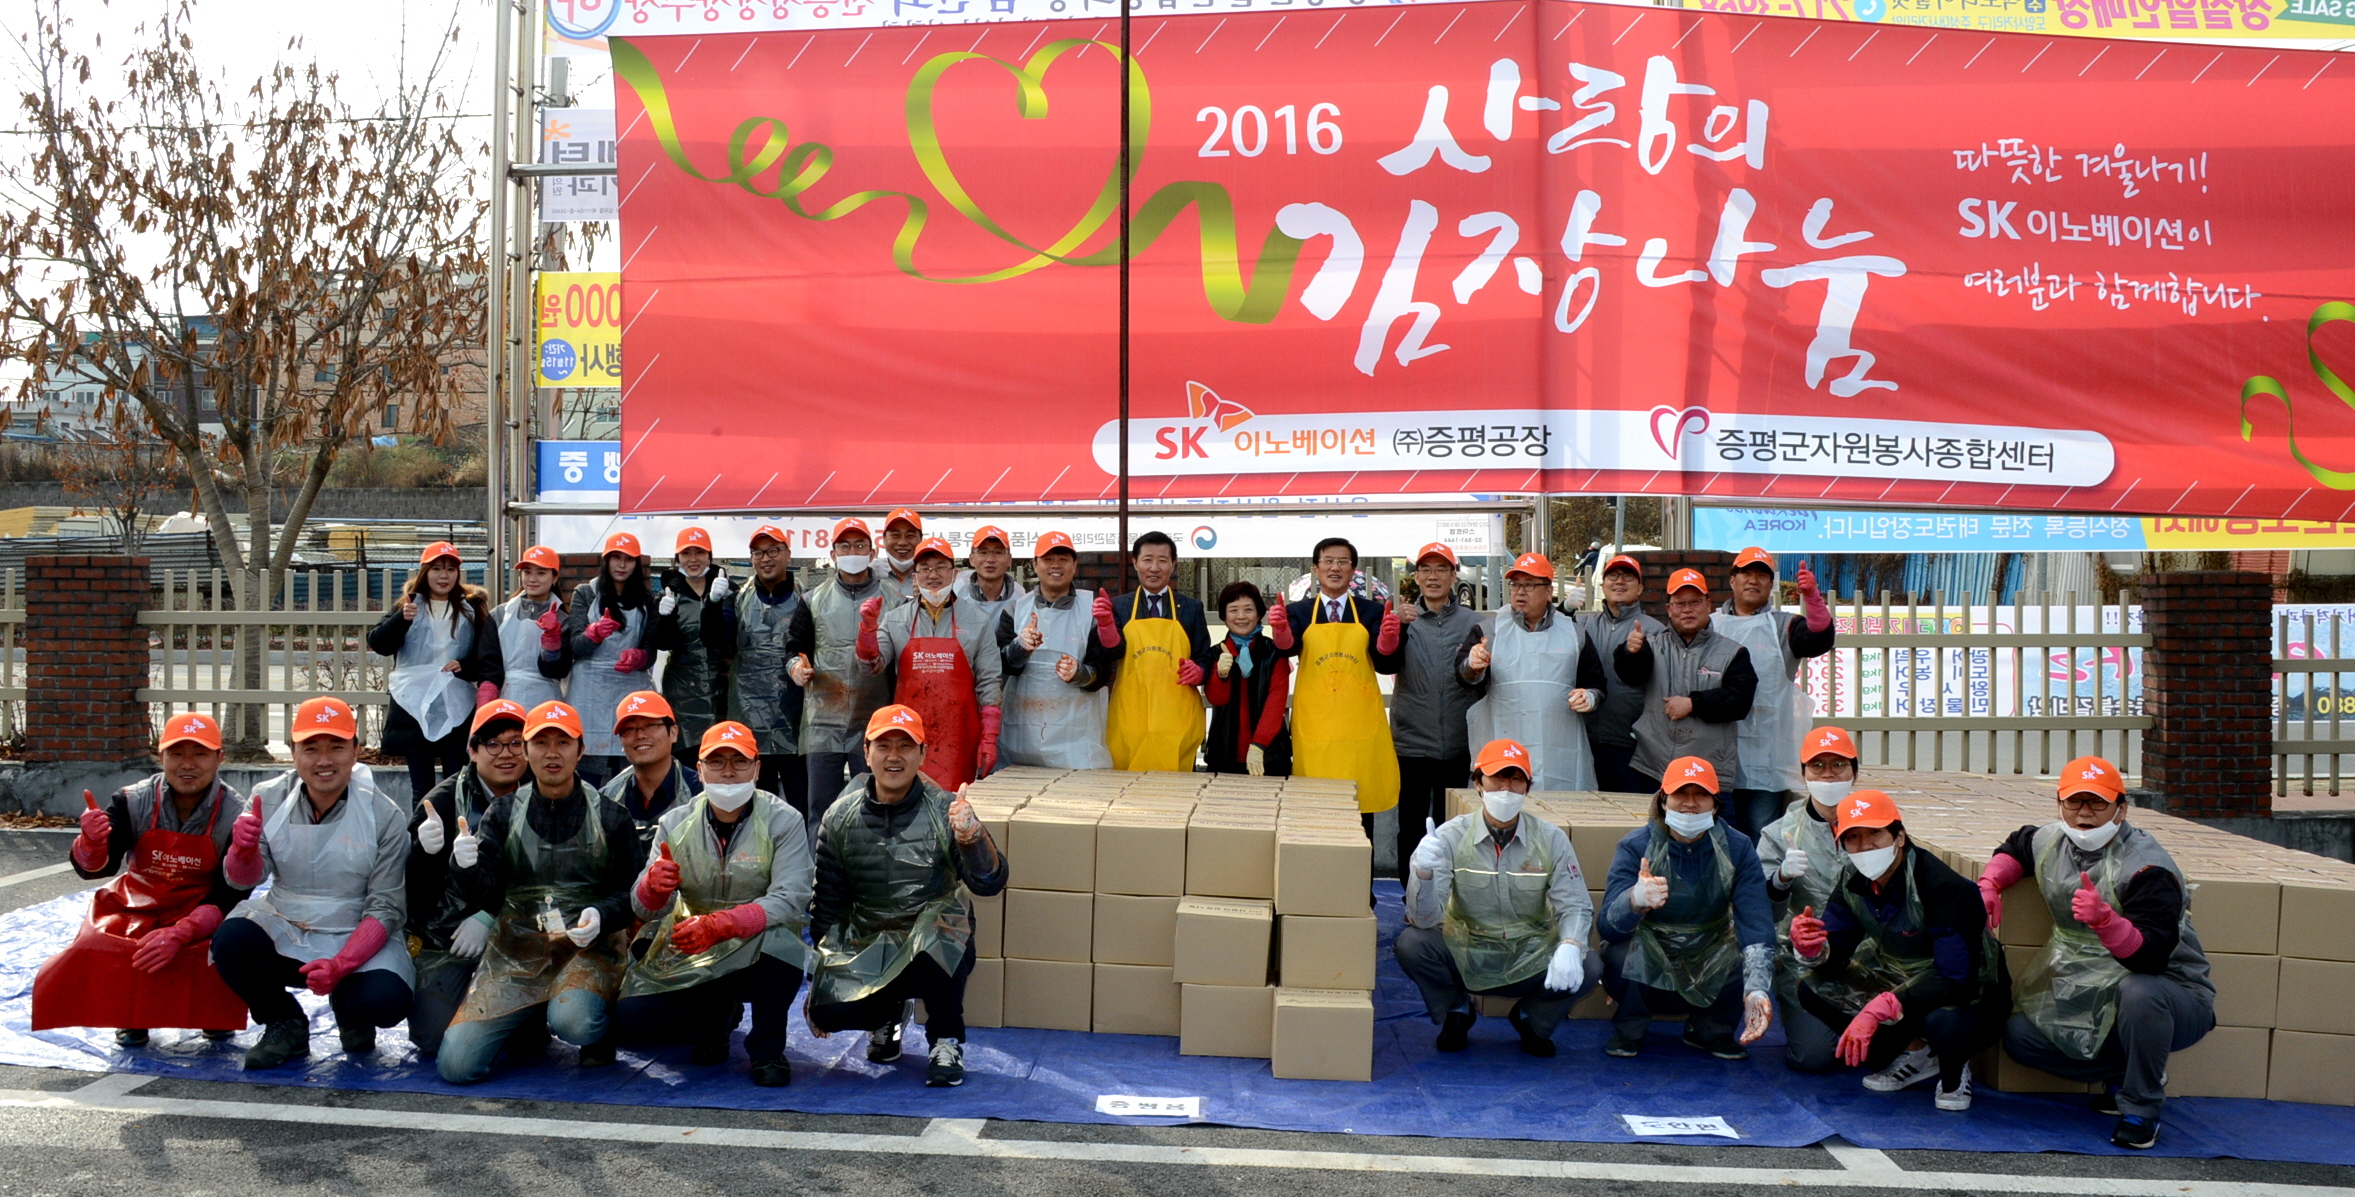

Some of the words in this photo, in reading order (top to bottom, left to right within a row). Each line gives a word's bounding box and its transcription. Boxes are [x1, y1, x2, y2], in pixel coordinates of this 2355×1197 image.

[1196, 102, 1342, 157] 2016
[1377, 56, 1769, 177] 사랑의
[1953, 138, 2062, 187] 따뜻한
[2075, 143, 2207, 199] 겨울나기!
[1959, 198, 2021, 240] SK
[2027, 210, 2211, 251] 이노베이션이
[1275, 188, 1907, 397] 김장나눔
[1964, 262, 2082, 311] 여러분과
[2095, 271, 2268, 322] 함께합니다.
[1155, 427, 1208, 459] SK
[1234, 428, 1375, 457] 이노베이션
[1393, 424, 1551, 459] (주)증평공장
[1716, 429, 2054, 473] 증평군자원봉사종합센터
[912, 652, 924, 660] SK
[627, 703, 639, 712] SK
[316, 713, 330, 722] SK
[546, 711, 560, 719] SK
[892, 716, 905, 724] SK
[183, 725, 196, 734] SK
[721, 731, 735, 740] SK
[1819, 738, 1832, 747] SK
[1503, 750, 1516, 758] SK
[1684, 769, 1697, 777] SK
[2082, 771, 2096, 779] SK
[1850, 808, 1864, 818] SK
